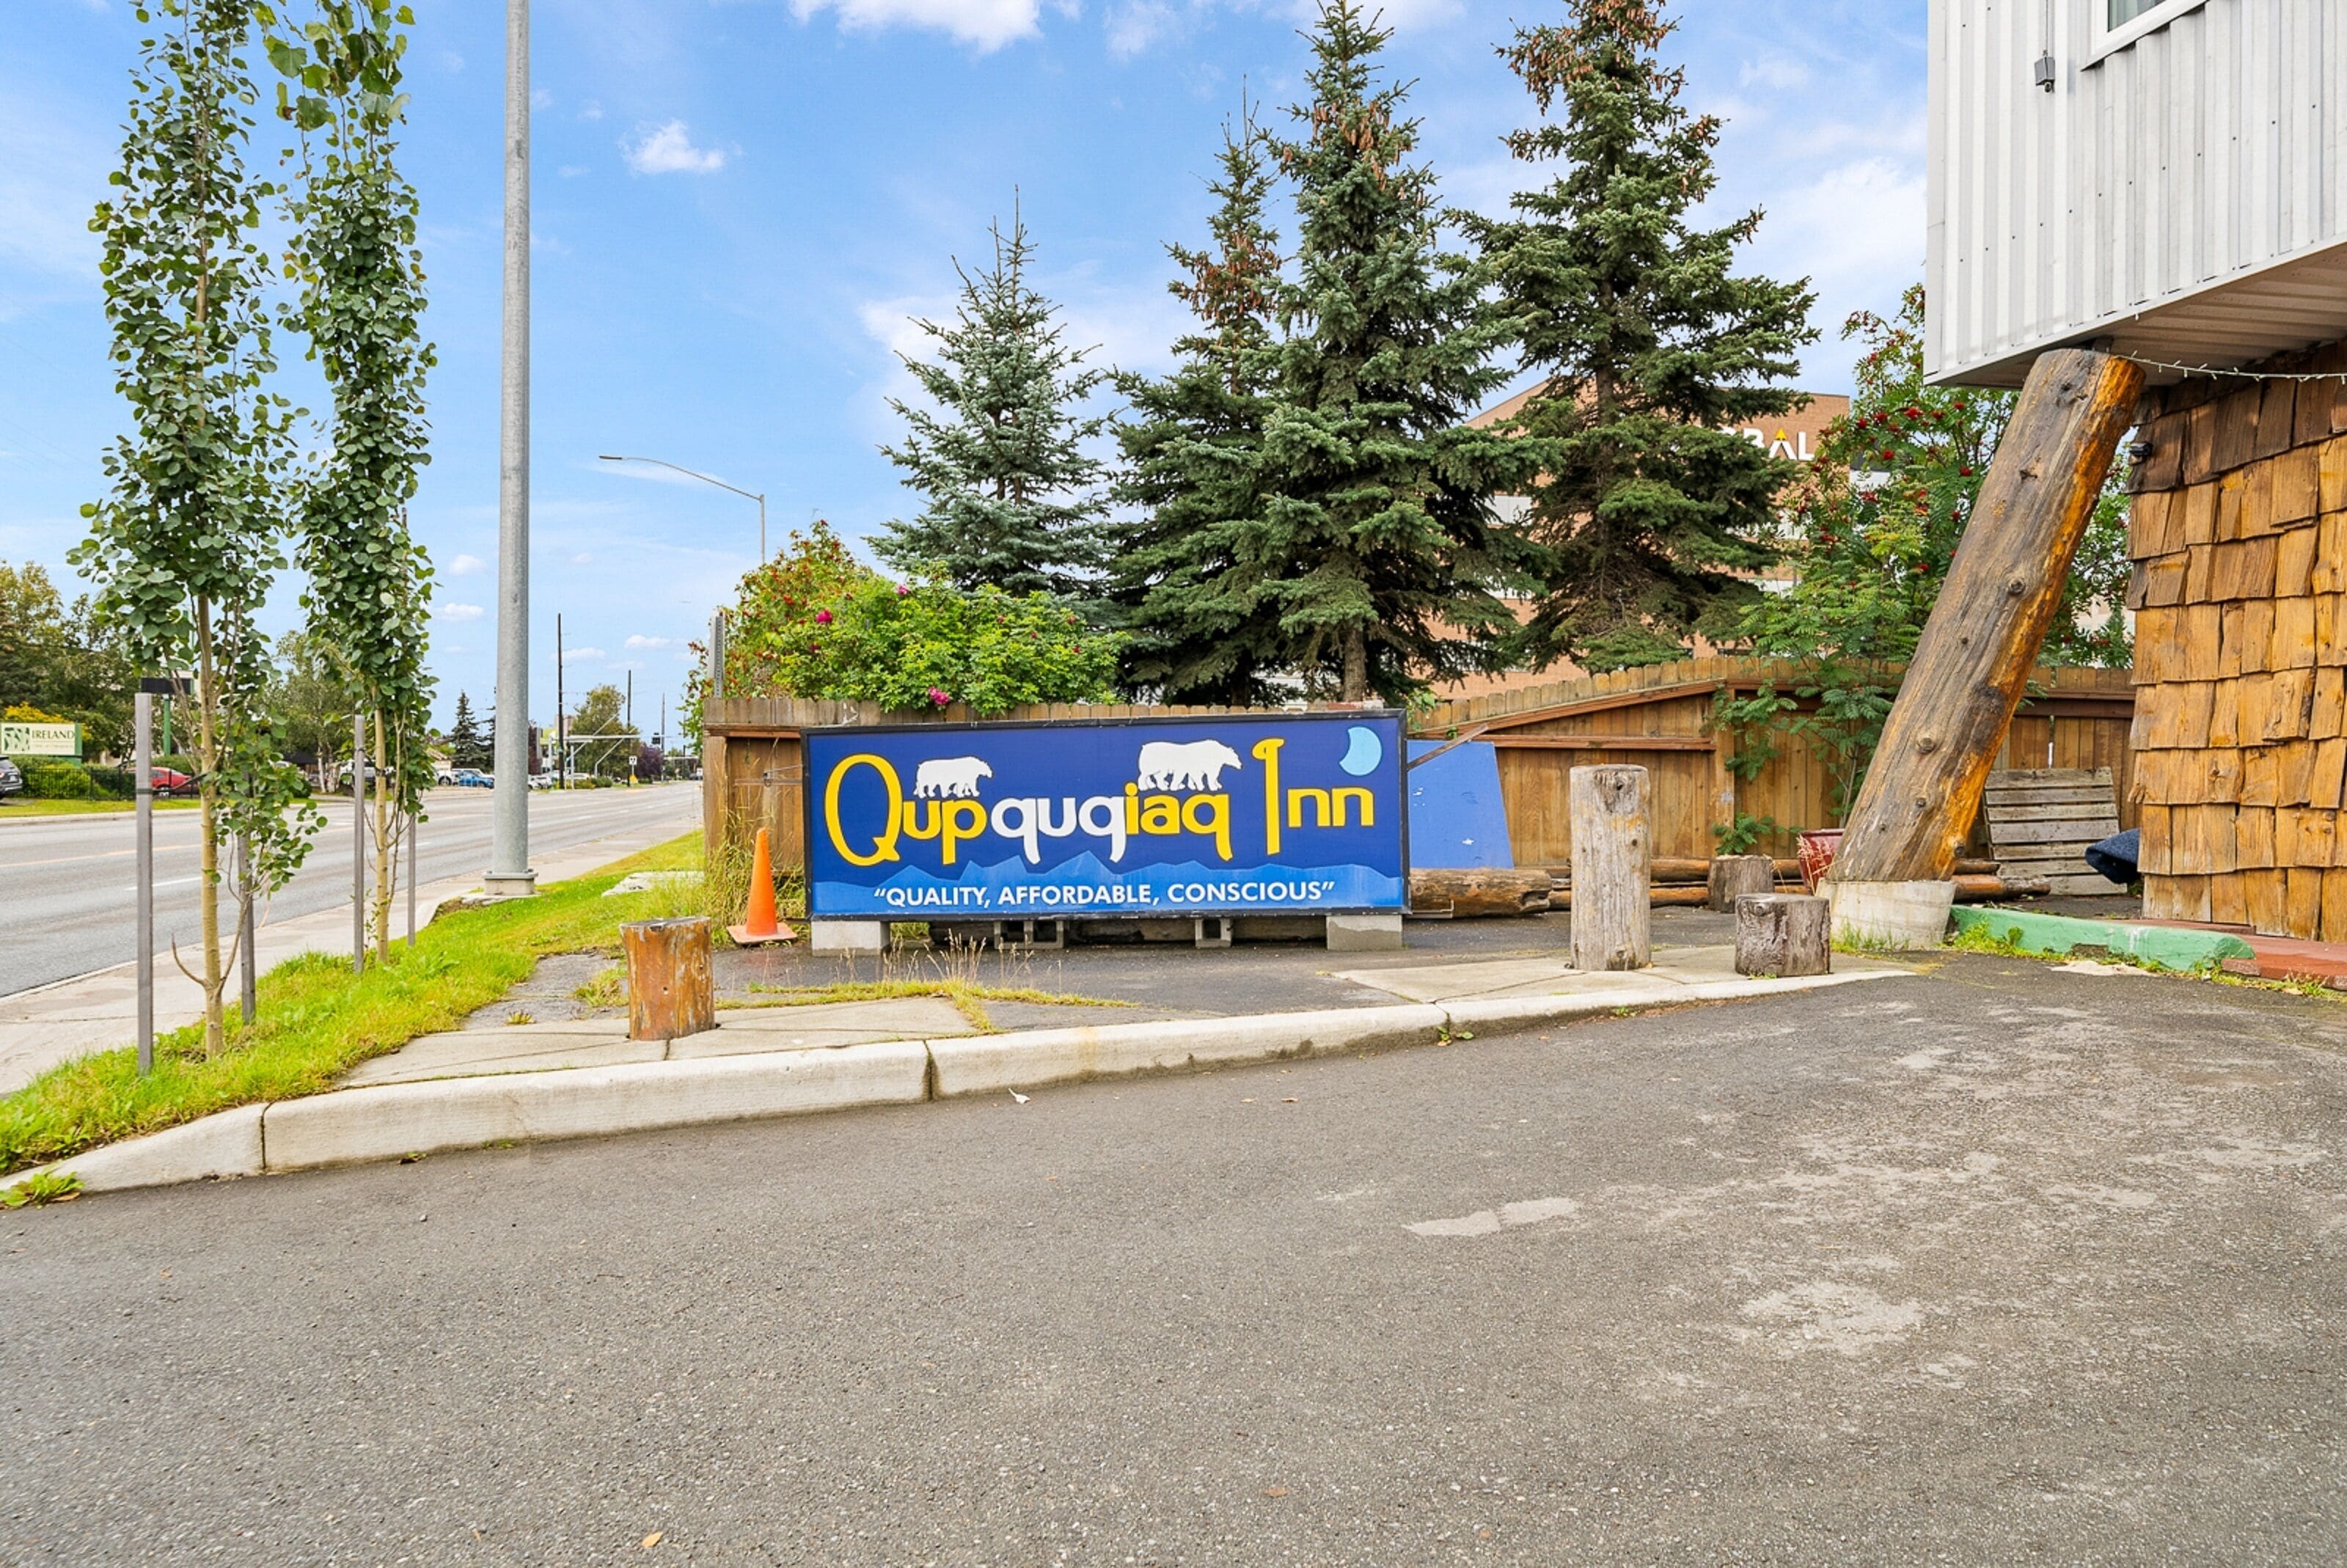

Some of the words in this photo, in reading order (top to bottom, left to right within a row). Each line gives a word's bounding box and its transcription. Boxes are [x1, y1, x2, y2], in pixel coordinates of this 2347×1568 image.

[32, 730, 76, 739] IRELAND
[1252, 738, 1374, 855] Inn
[874, 887, 991, 908] “QUALITY,
[998, 885, 1160, 906] AFFORDABLE,
[1167, 882, 1335, 903] CONSCIOUS”
